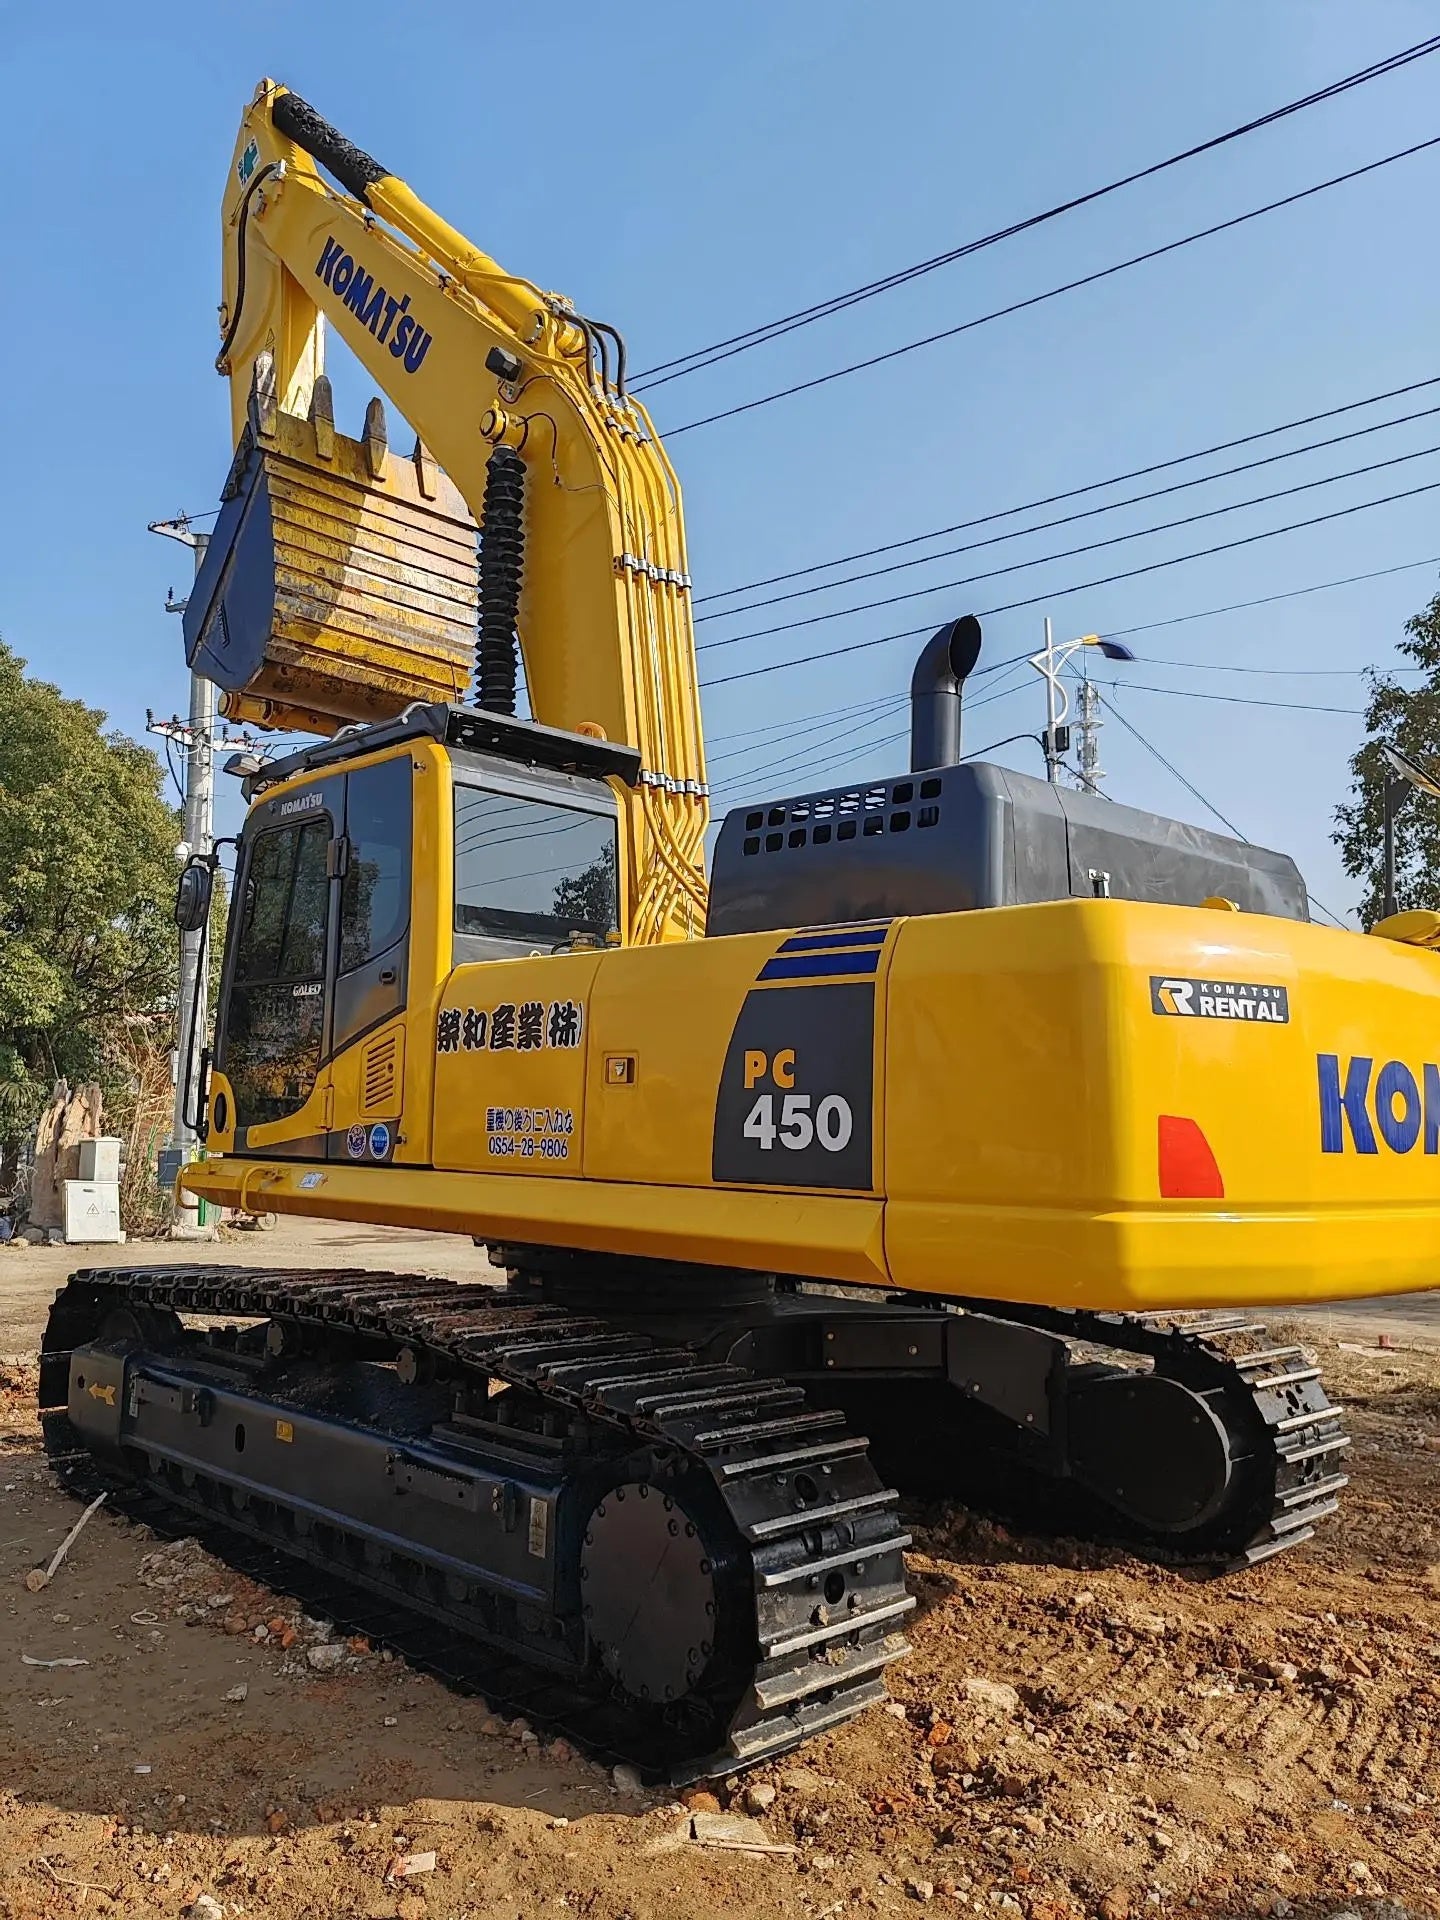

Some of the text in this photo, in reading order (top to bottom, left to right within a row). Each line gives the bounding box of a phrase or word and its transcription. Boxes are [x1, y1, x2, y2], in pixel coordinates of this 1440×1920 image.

[314, 235, 433, 374] KOMATSU
[280, 792, 323, 816] KOMATSU
[1200, 983, 1280, 999] KOMATSU
[1199, 996, 1284, 1021] RENTAL
[743, 1048, 796, 1089] PC
[743, 1094, 853, 1152] 450
